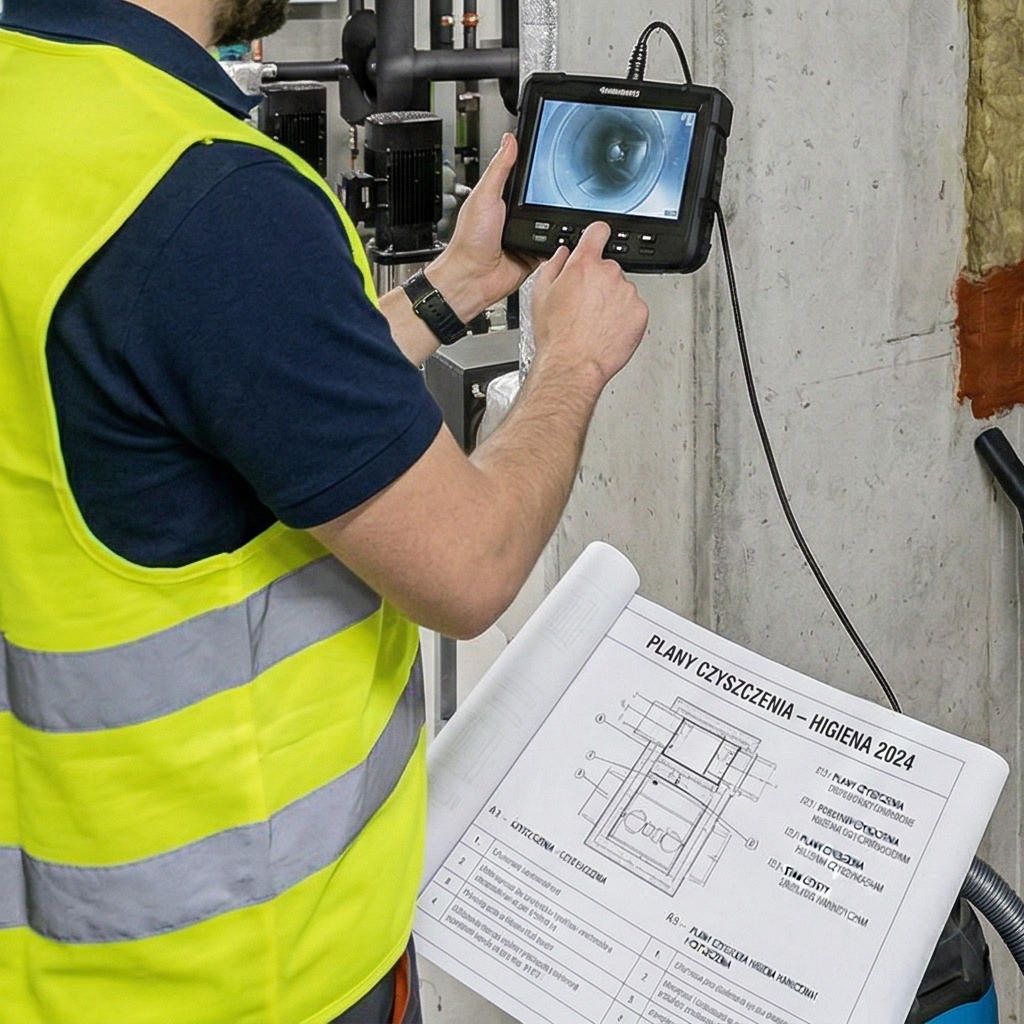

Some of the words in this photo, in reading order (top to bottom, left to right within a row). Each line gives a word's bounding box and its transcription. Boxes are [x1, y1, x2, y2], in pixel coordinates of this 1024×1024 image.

[645, 634, 698, 670] PLANY
[696, 661, 796, 721] CZYSZCZENIA
[808, 713, 873, 755] HIGIENA
[873, 741, 917, 772] 2024
